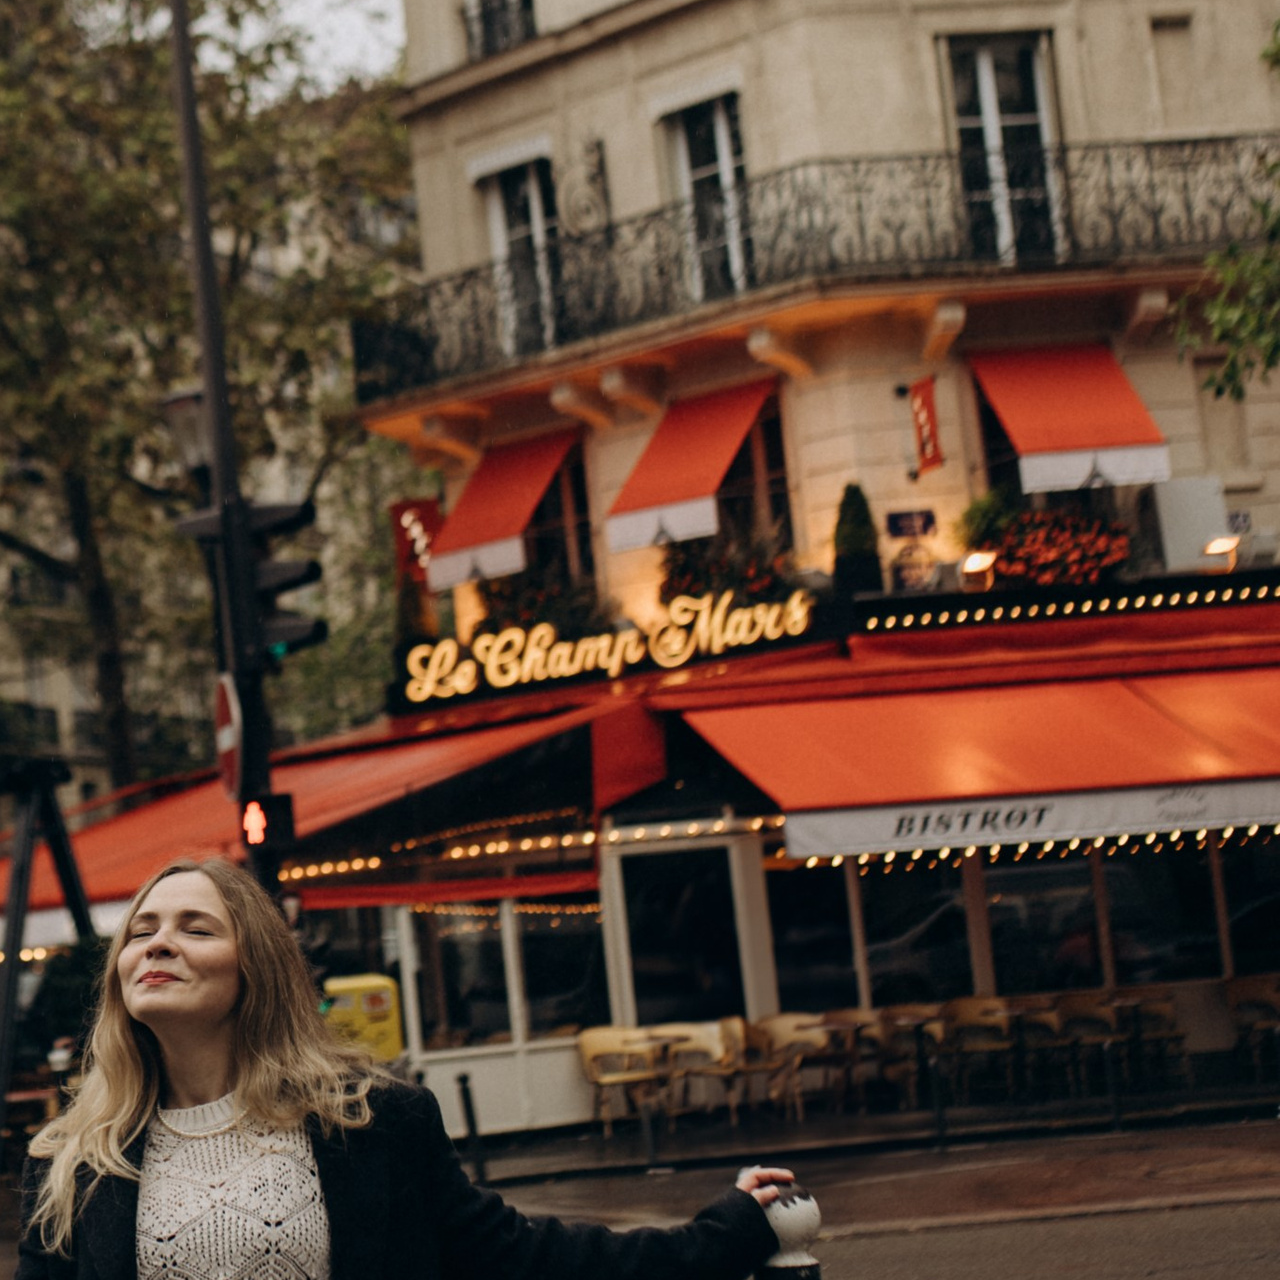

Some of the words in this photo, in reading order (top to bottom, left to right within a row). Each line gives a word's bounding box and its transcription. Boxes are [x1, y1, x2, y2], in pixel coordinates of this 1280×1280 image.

[405, 637, 477, 702] Le
[473, 622, 646, 688] Champ
[648, 588, 816, 668] Mars
[893, 802, 1055, 839] BISTROT
